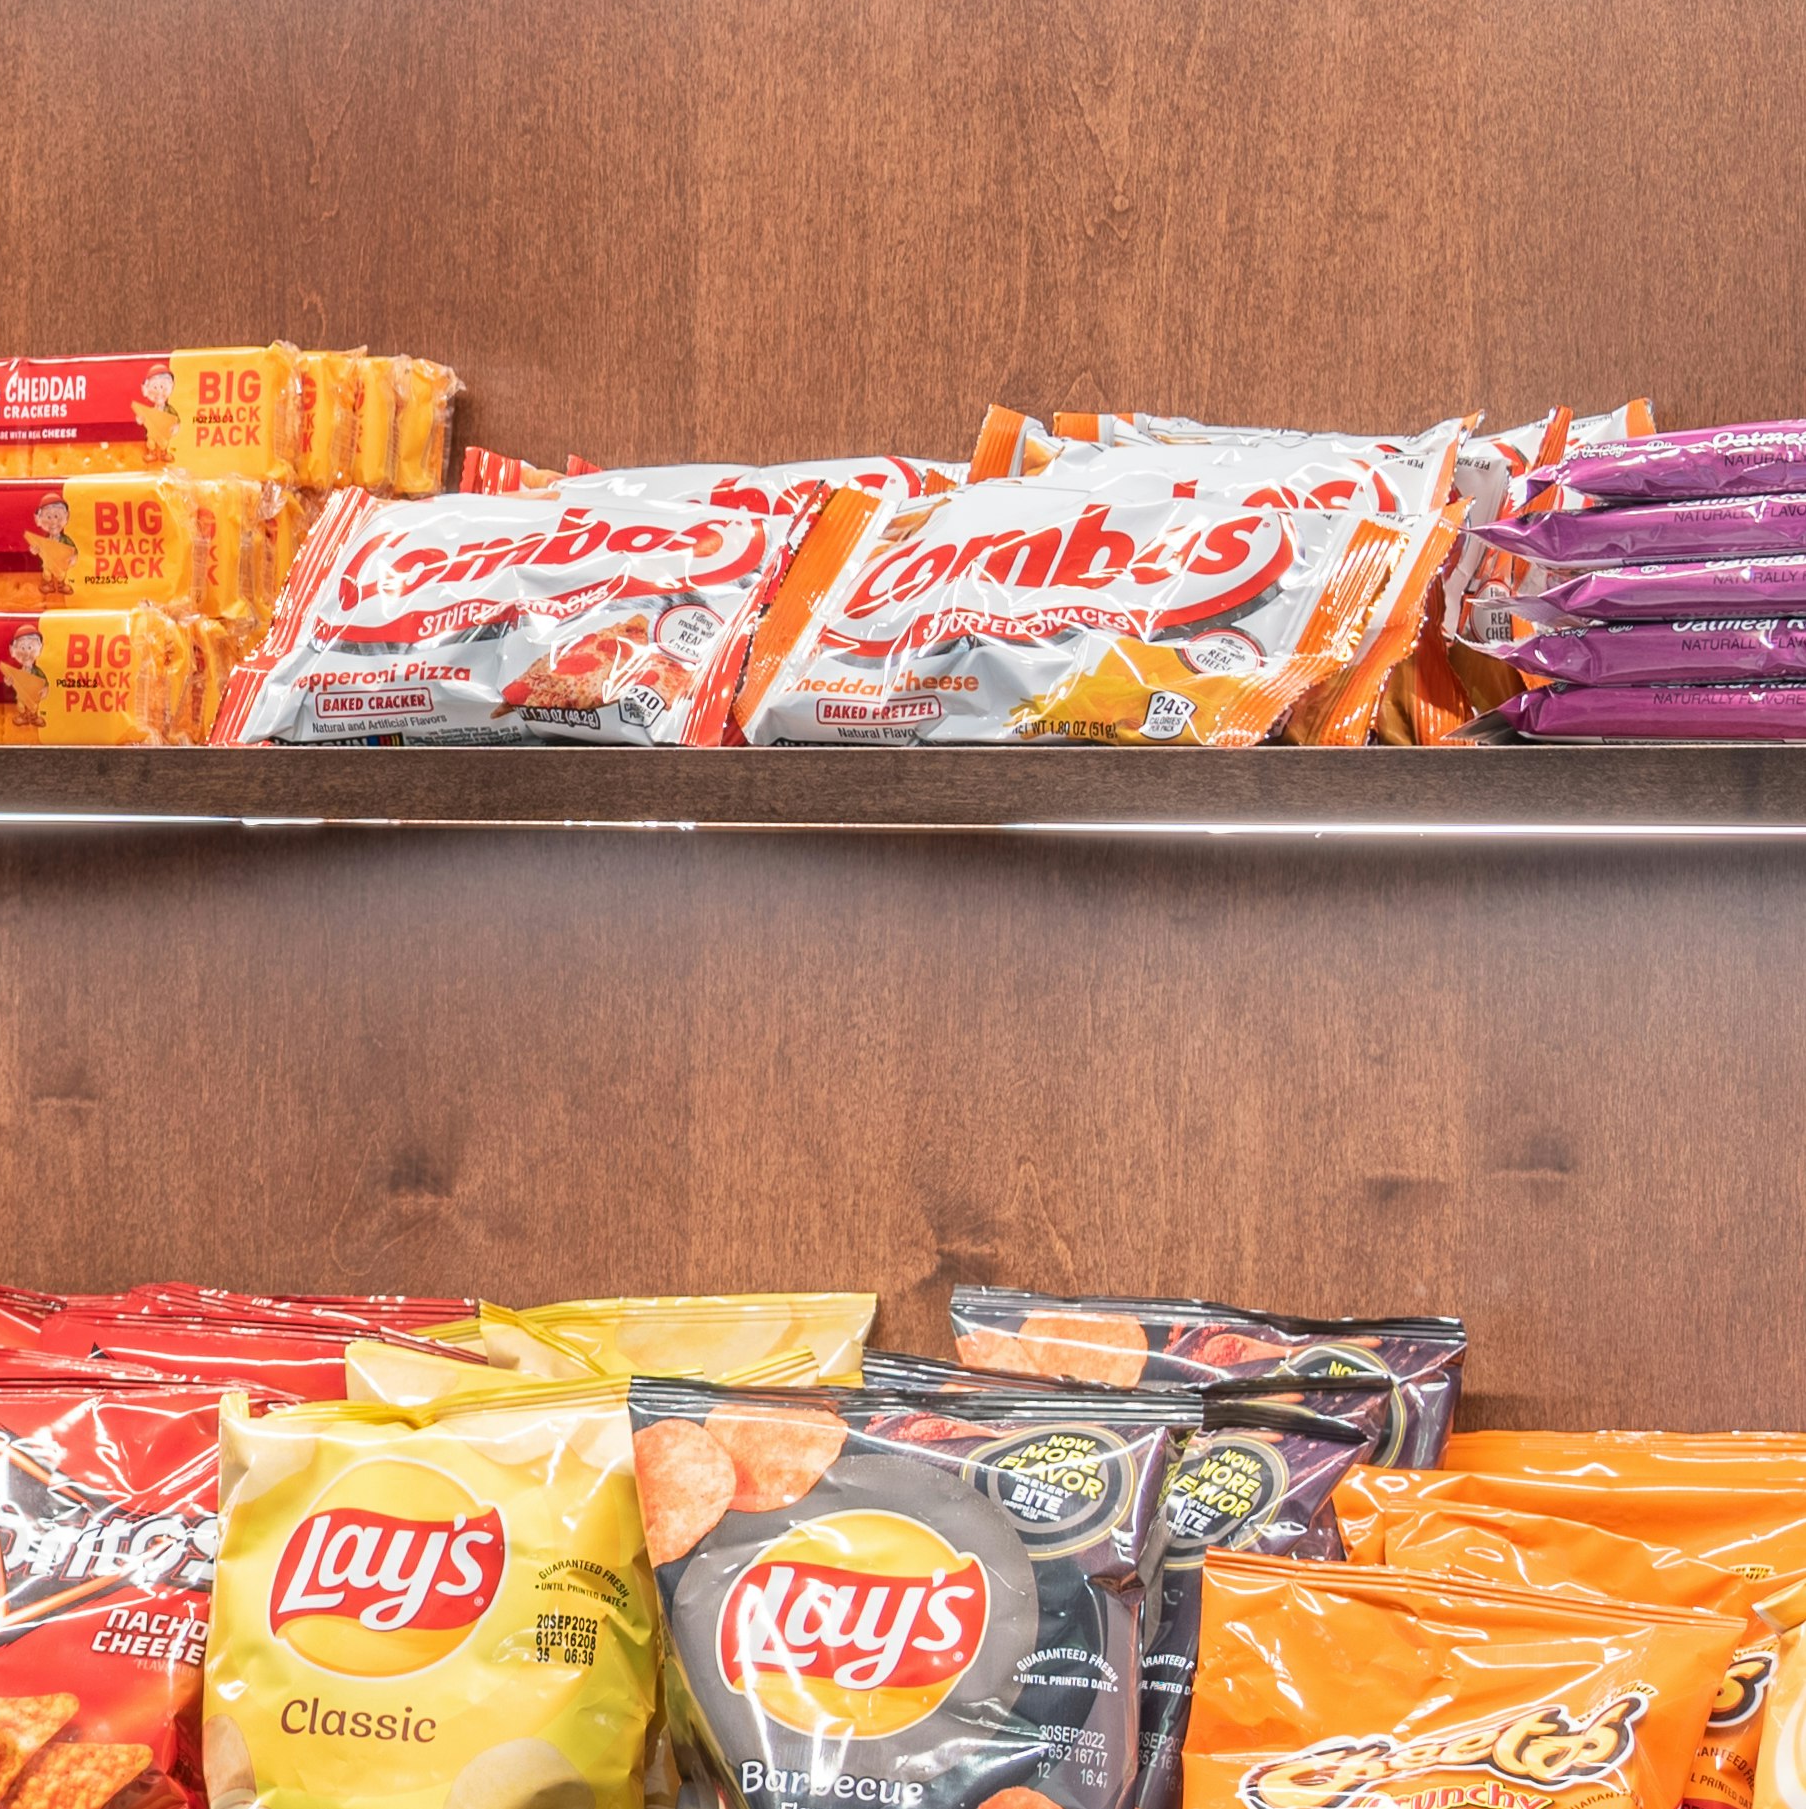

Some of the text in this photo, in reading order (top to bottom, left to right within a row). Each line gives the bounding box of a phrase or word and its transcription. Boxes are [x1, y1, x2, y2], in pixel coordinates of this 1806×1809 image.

[6, 374, 87, 403] CHEDDAR
[198, 370, 261, 405] BIG
[4, 404, 67, 419] CRACKERS
[195, 426, 261, 448] PACK
[94, 501, 163, 536] BIG
[94, 539, 165, 556] SNACK
[95, 558, 164, 580] PACK
[66, 633, 131, 670] BIG
[293, 661, 472, 695] epperoni Pizza
[65, 691, 128, 713] PACK
[322, 693, 426, 713] BAKED CRACKER
[824, 700, 936, 721] BAKED PRETZEL
[312, 713, 447, 734] Natural and Artificial Flavors
[1031, 721, 1045, 735] WT
[1049, 720, 1069, 735] 1.80
[1071, 720, 1086, 735] OZ
[1048, 1435, 1096, 1452] NOW
[1023, 1444, 1103, 1475] MORE
[998, 1454, 1106, 1501] FLAVOR
[1011, 1490, 1062, 1514] BITE
[288, 1514, 493, 1632] Lay's
[539, 1559, 630, 1598] GUARANTEED FRESH
[541, 1583, 564, 1592] UNTIL
[600, 1594, 622, 1608] DATE
[107, 1609, 208, 1643] NACHO
[536, 1614, 598, 1635] 20SEP2022
[734, 1566, 975, 1690] Lay's
[91, 1631, 206, 1665] CHEESE
[536, 1631, 596, 1650] 612316208
[537, 1647, 594, 1666] 35 06:39
[1016, 1647, 1119, 1682] GUARANTEED FRESH
[1020, 1674, 1112, 1692] UNTIL PRINTED DATE
[280, 1699, 438, 1743] Classic
[1249, 1704, 1637, 1798] Cheetos
[741, 1760, 924, 1805] Barbecue
[1037, 1762, 1050, 1779] 12
